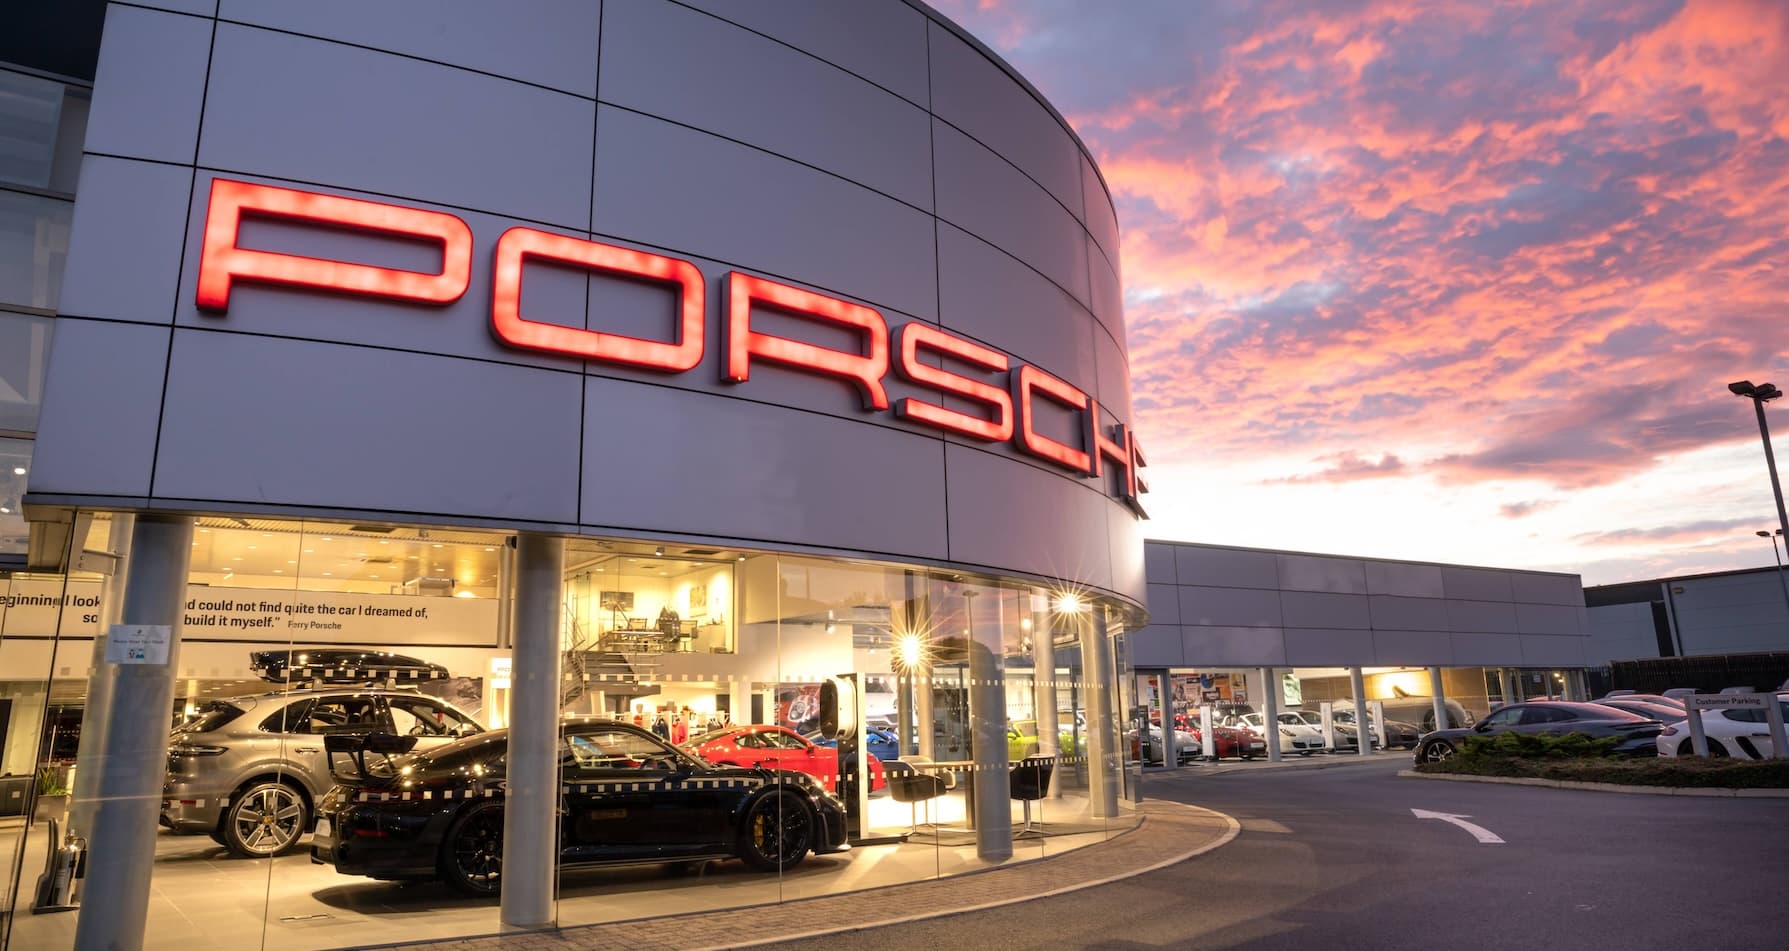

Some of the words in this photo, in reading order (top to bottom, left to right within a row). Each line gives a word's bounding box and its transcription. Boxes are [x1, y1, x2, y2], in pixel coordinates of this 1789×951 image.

[195, 176, 1149, 520] PORSCHE
[185, 599, 196, 610] d
[198, 600, 234, 611] could
[236, 601, 256, 612] not
[259, 601, 282, 613] find
[284, 602, 314, 616] quite
[317, 604, 336, 614] the
[338, 606, 356, 615] car
[358, 605, 362, 615] I
[364, 605, 413, 617] dreamed
[414, 607, 428, 619] of,
[184, 614, 215, 626] build
[218, 615, 228, 626] it
[230, 616, 280, 630] myself."
[288, 620, 309, 631] Ferry
[310, 620, 342, 630] Porsche
[1695, 697, 1730, 705] Customer
[1731, 696, 1761, 705] Parking
